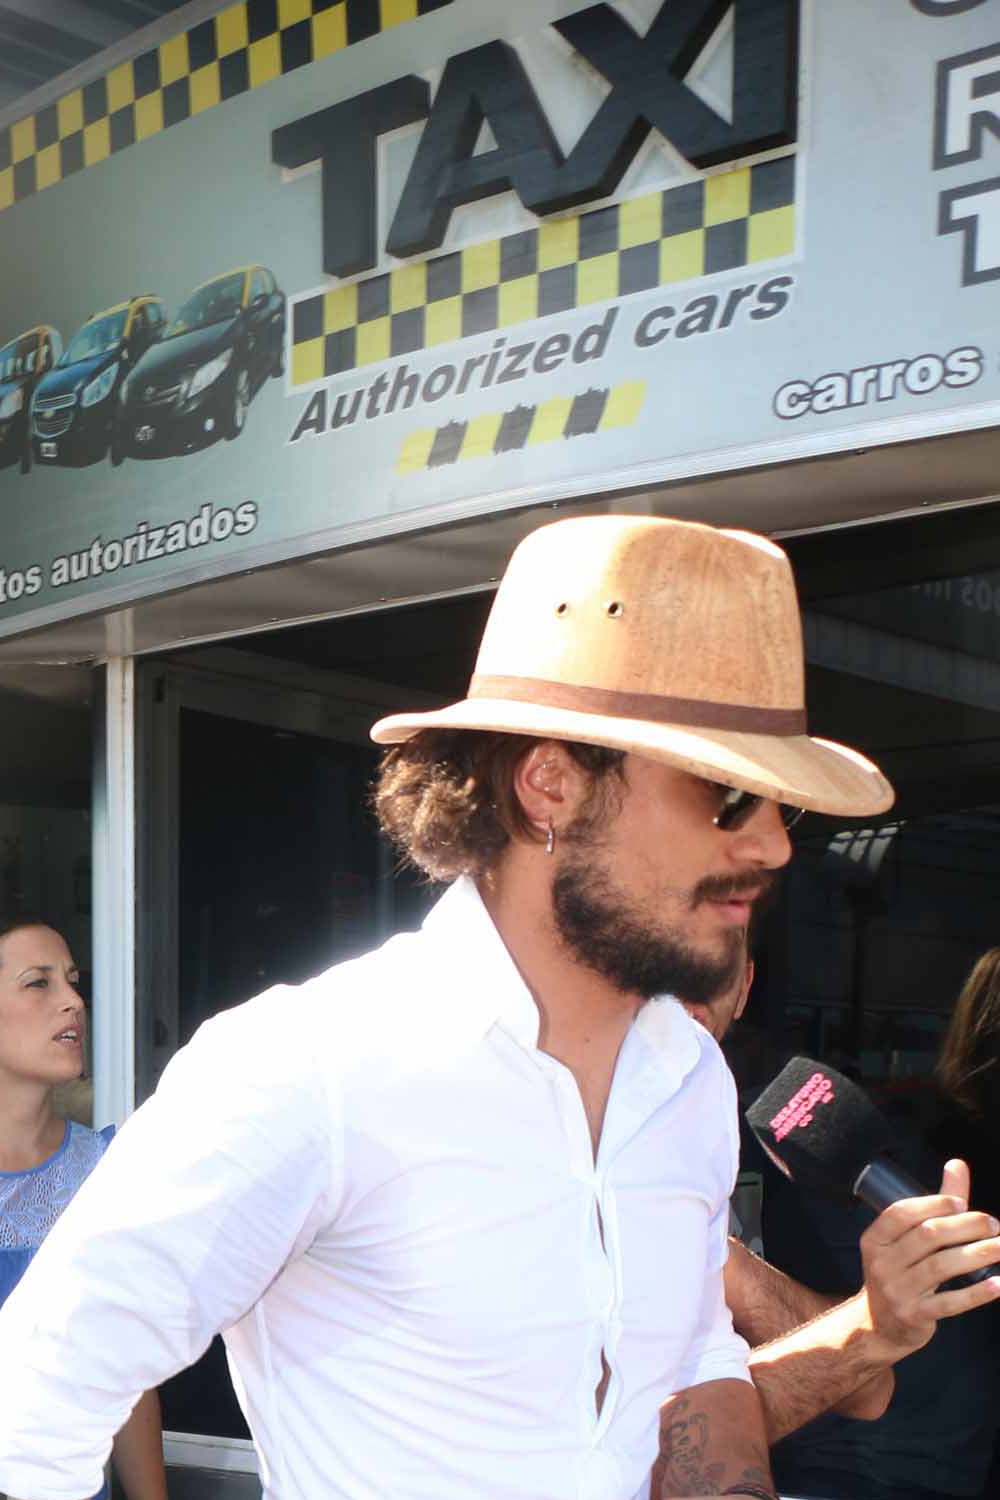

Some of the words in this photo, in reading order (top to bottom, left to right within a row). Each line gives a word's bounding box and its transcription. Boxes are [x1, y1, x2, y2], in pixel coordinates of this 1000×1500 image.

[272, 0, 798, 278] TAXI
[288, 306, 620, 443] Authorized
[634, 275, 795, 349] cars
[773, 346, 983, 421] carros
[50, 501, 258, 588] autorizados
